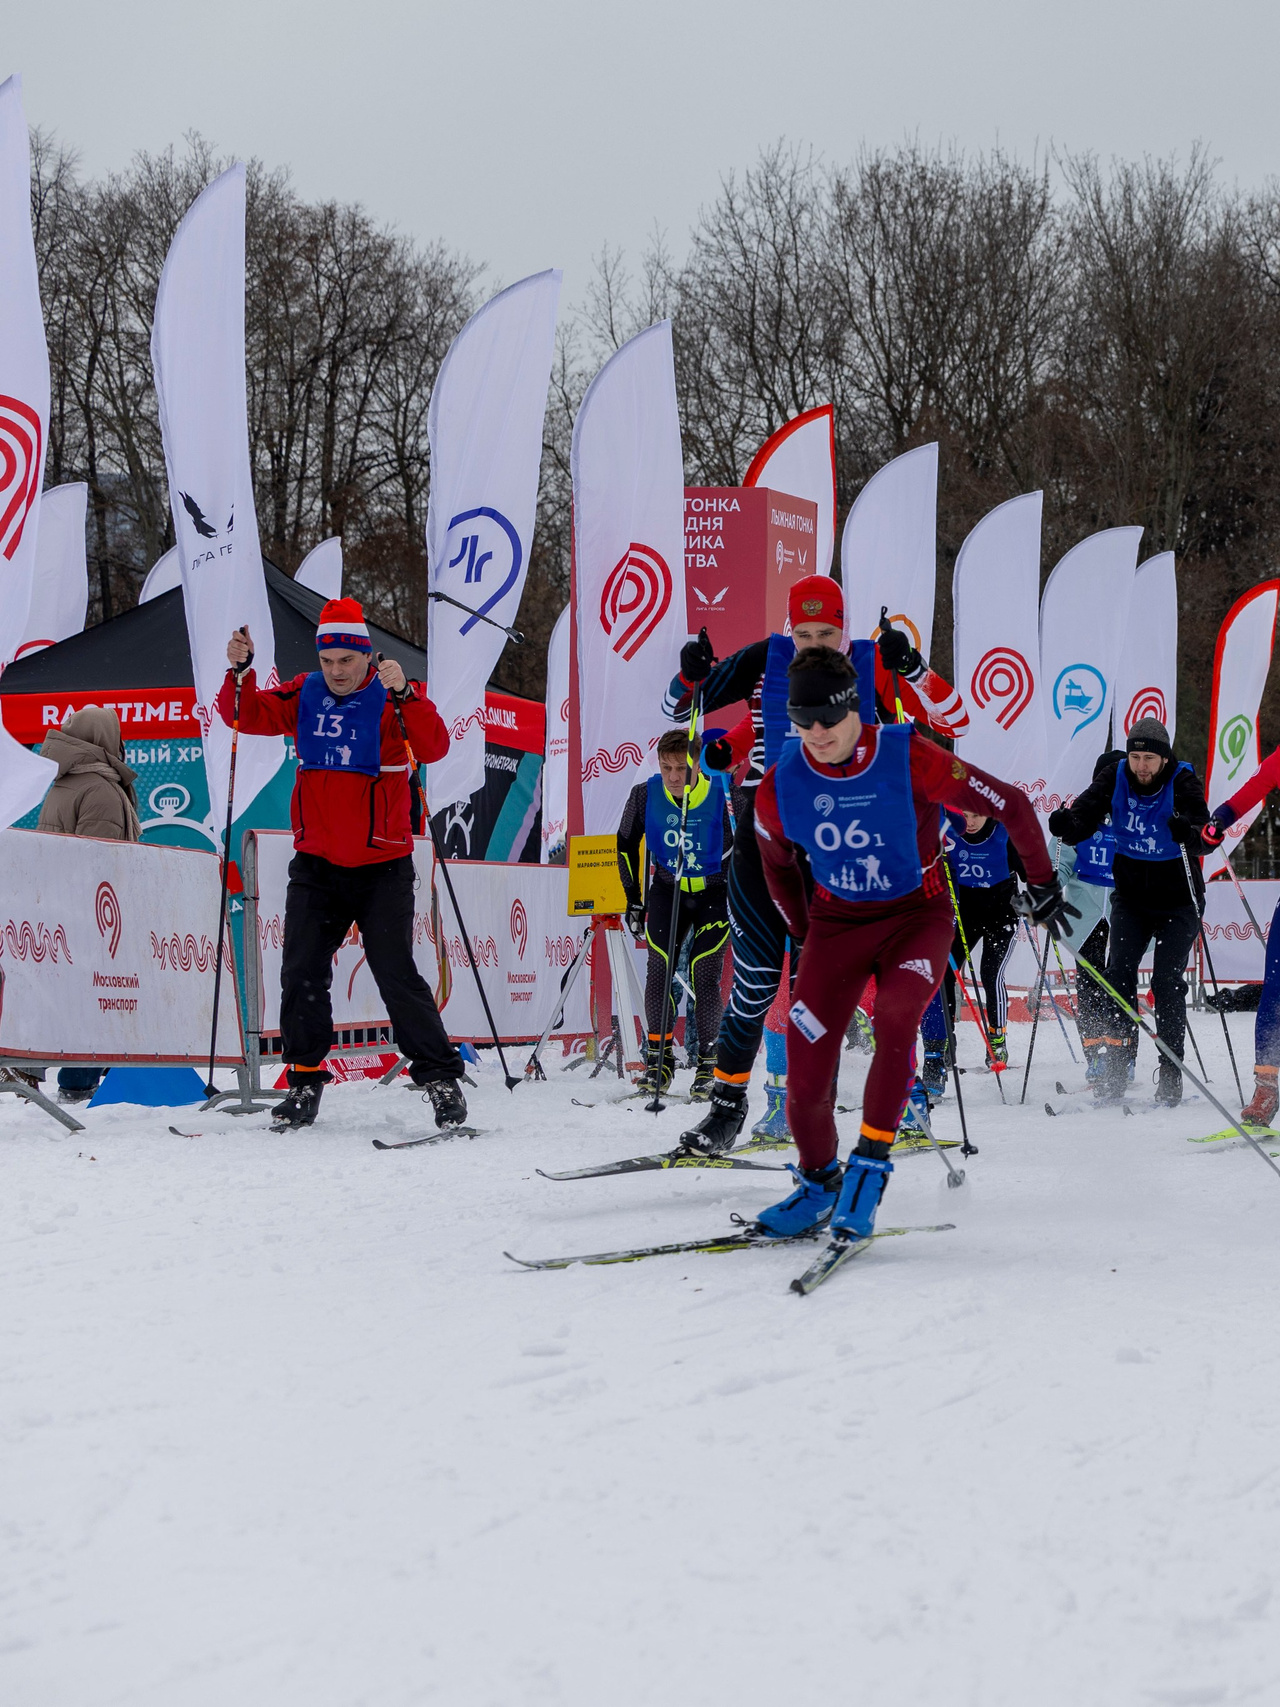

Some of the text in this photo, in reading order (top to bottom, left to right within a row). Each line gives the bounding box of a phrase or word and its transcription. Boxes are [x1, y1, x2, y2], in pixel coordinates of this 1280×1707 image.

[685, 516, 723, 533] ДНЯ
[685, 553, 718, 568] ТВА
[313, 714, 344, 738] 13
[968, 776, 1006, 811] SCANIA
[1125, 811, 1146, 835] 14
[663, 829, 694, 851] 05
[814, 819, 871, 851] 06
[1089, 846, 1110, 867] 11
[958, 863, 984, 878] 20
[93, 971, 140, 989] Московский
[899, 962, 935, 985] adidas
[98, 997, 138, 1014] транспорт
[673, 1157, 734, 1169] FISCHER
